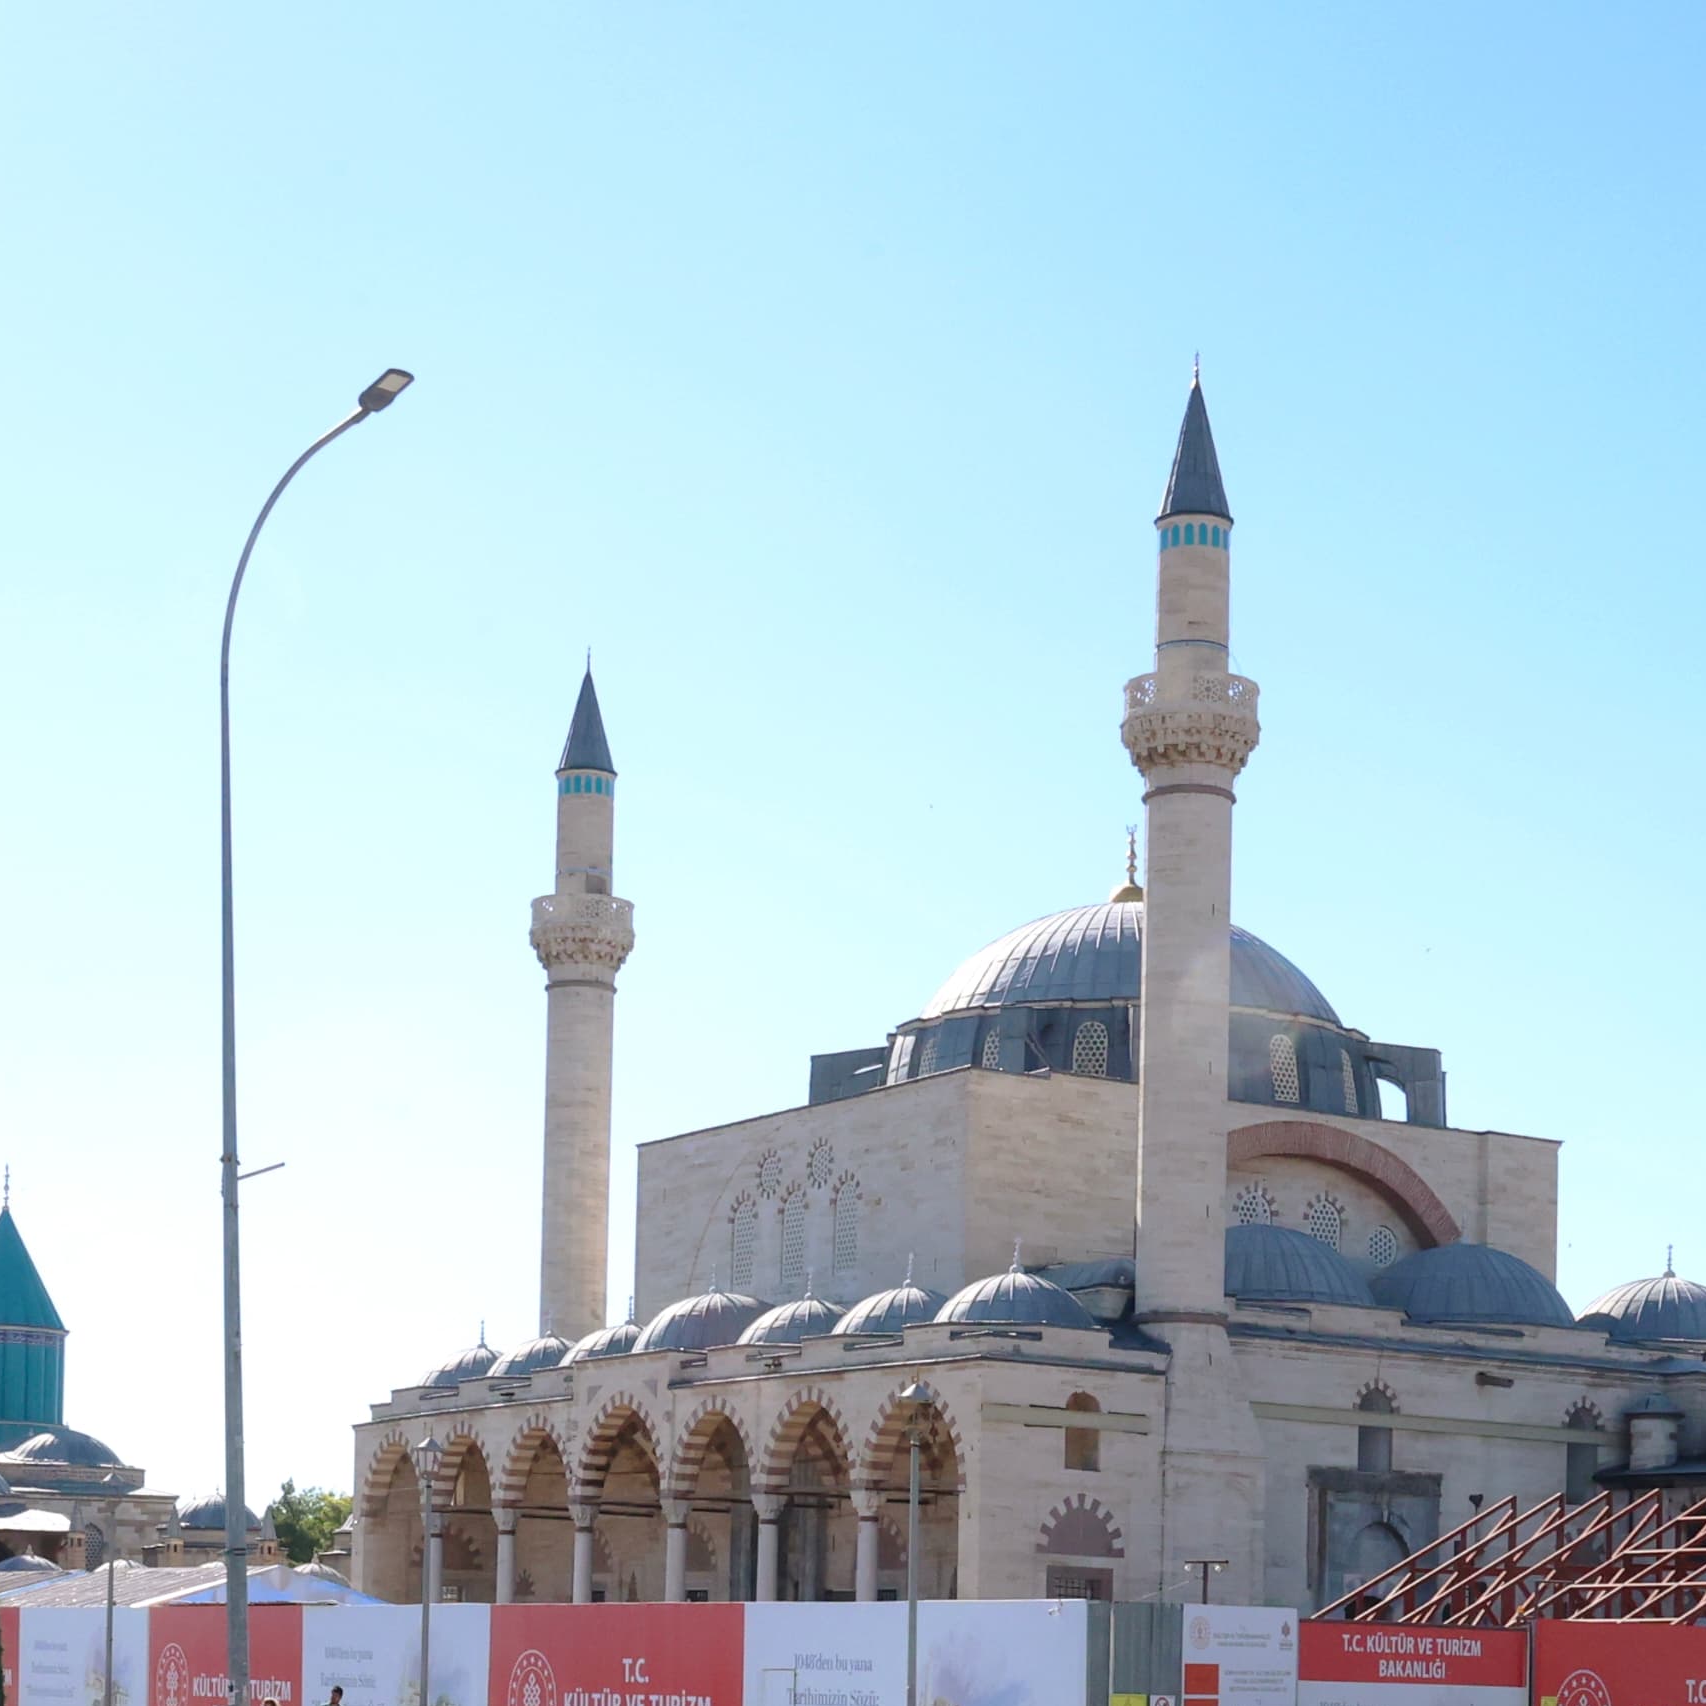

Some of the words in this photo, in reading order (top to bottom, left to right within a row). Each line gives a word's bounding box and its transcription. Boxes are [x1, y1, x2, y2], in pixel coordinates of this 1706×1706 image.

[1342, 1634, 1364, 1652] T.C.
[1366, 1632, 1415, 1655] KÜLTÜR
[1417, 1638, 1434, 1655] VE
[1436, 1636, 1482, 1657] TURİZM
[622, 1657, 650, 1683] T.C.
[835, 1653, 848, 1671] bu
[848, 1657, 873, 1675] yana
[1378, 1658, 1446, 1679] BAKANLIĞI
[249, 1676, 291, 1701] TURİZM
